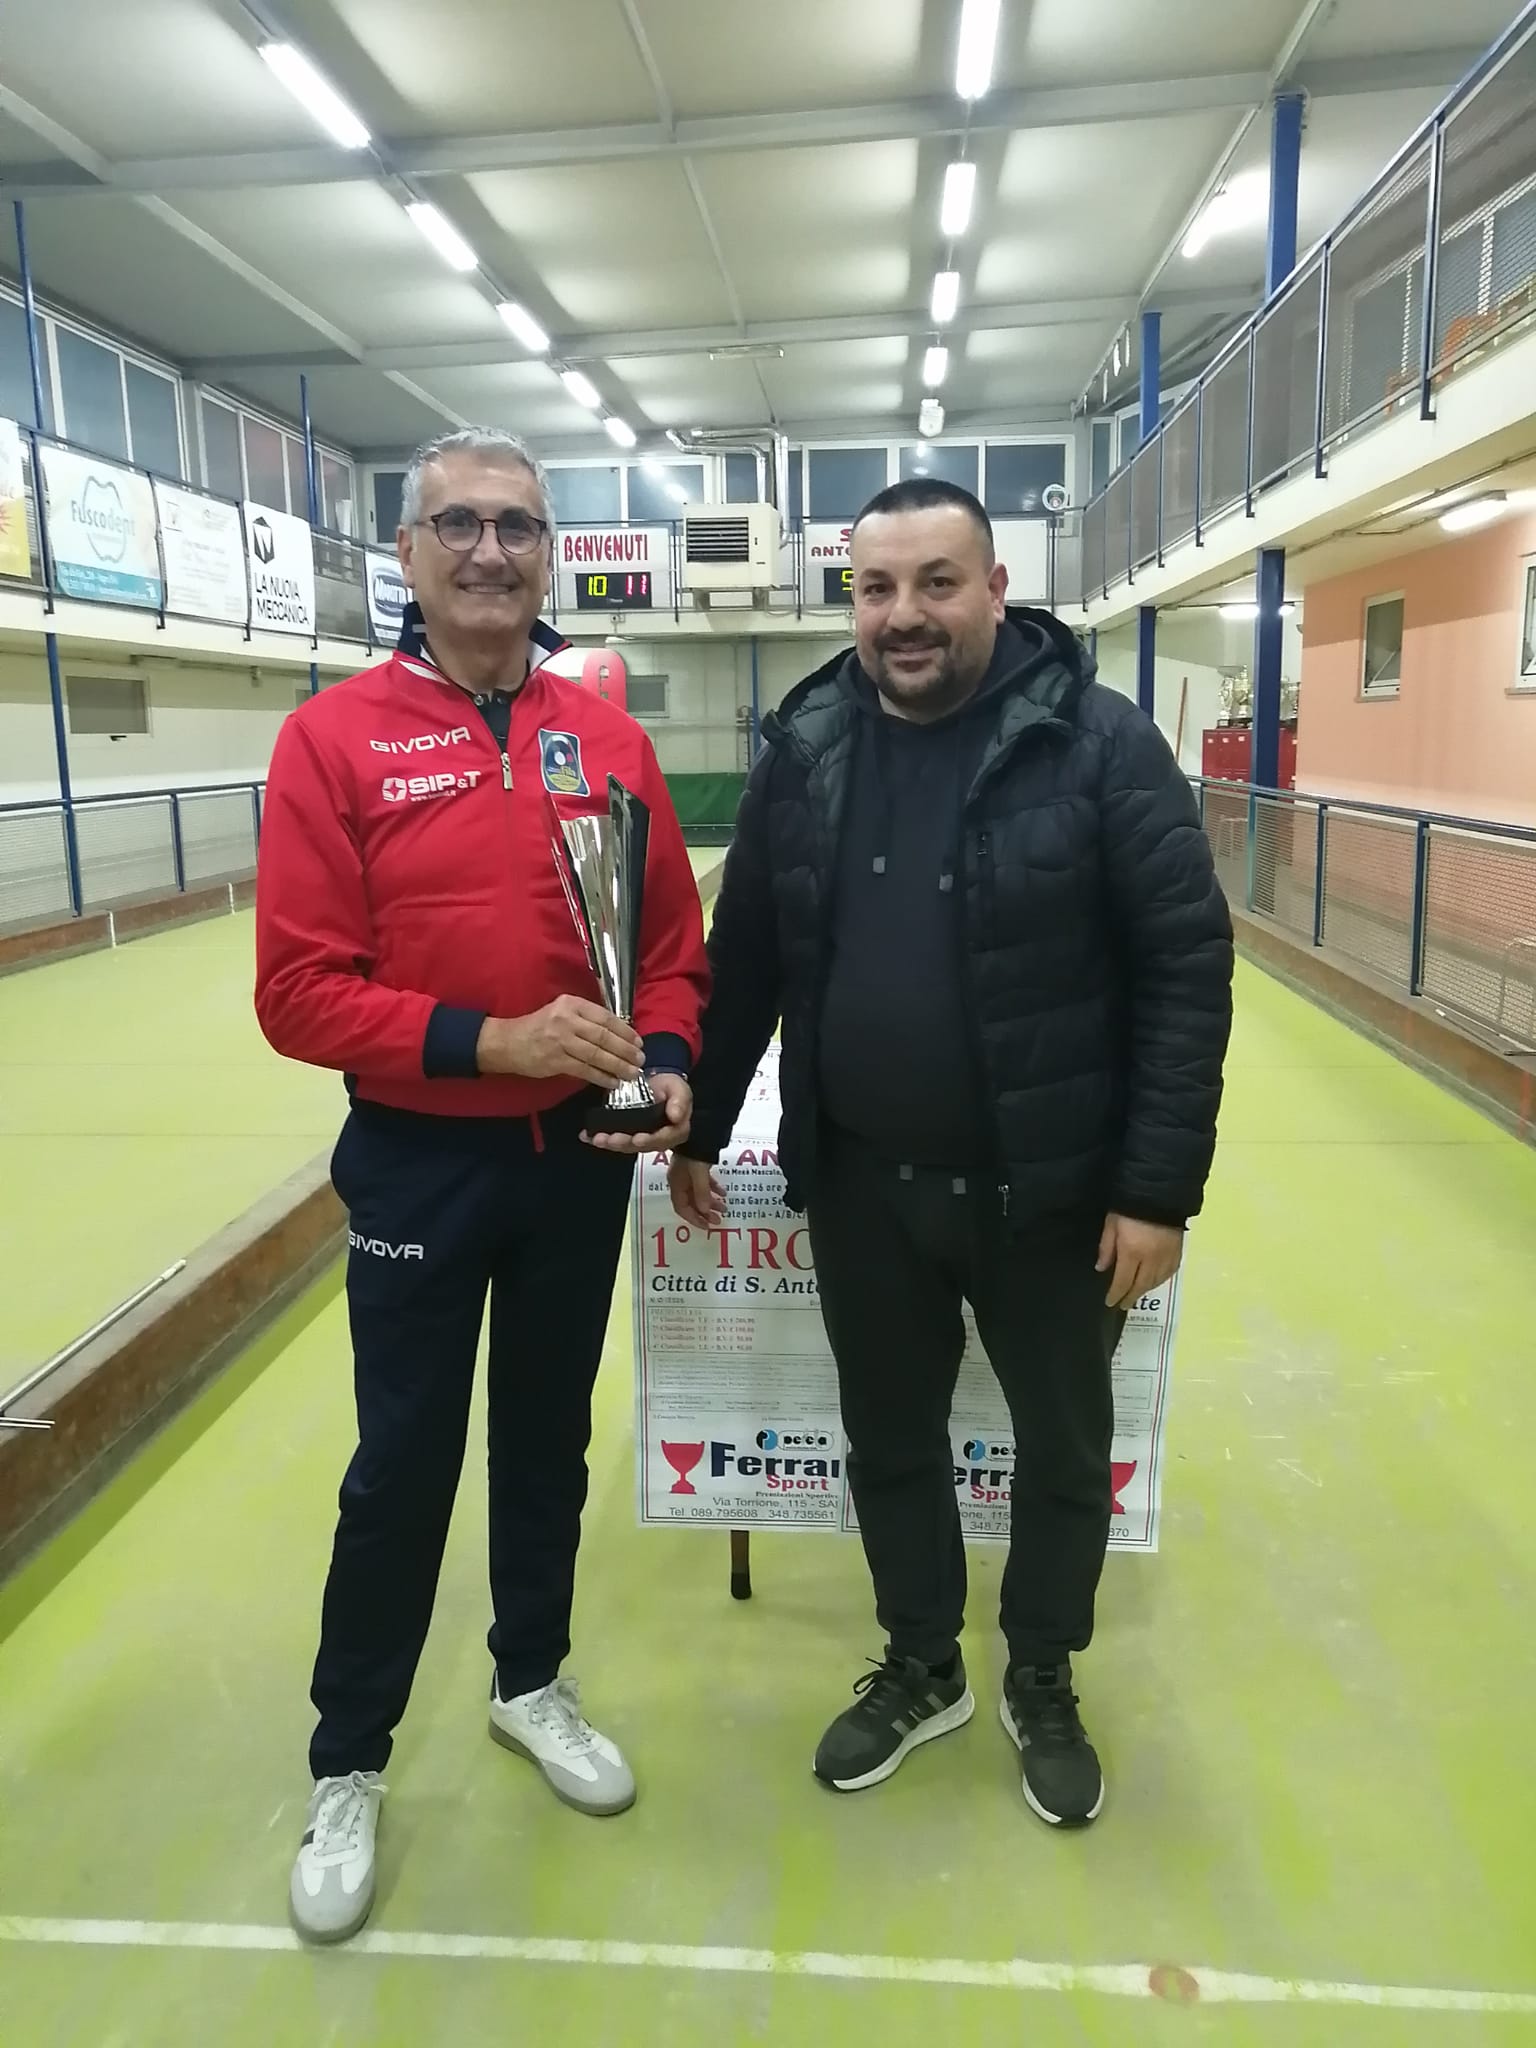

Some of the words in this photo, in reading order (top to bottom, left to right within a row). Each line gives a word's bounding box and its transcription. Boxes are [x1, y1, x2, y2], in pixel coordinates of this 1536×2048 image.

[564, 534, 648, 562] BENVENUTI
[254, 572, 268, 594] LA
[269, 575, 301, 601] NUOVA
[588, 575, 607, 596] 10
[256, 597, 309, 625] MECCANICA
[369, 726, 472, 754] GIVOVA
[407, 770, 481, 795] SIP&T
[719, 1168, 730, 1176] Via
[648, 1182, 663, 1192] dal
[725, 1182, 740, 1192] aio
[741, 1183, 764, 1192] 2026
[766, 1184, 782, 1192] ore
[748, 1196, 770, 1206] Gara
[652, 1275, 708, 1292] Città
[715, 1276, 737, 1293] di
[744, 1276, 766, 1293] S.
[1132, 1295, 1161, 1311] te
[767, 1473, 829, 1492] Sport
[953, 1465, 1015, 1488] err
[712, 1496, 732, 1507] Via
[789, 1499, 808, 1509] 115
[669, 1506, 685, 1517] Tel
[690, 1507, 759, 1519] 089.795608
[768, 1509, 835, 1520] 348.735561
